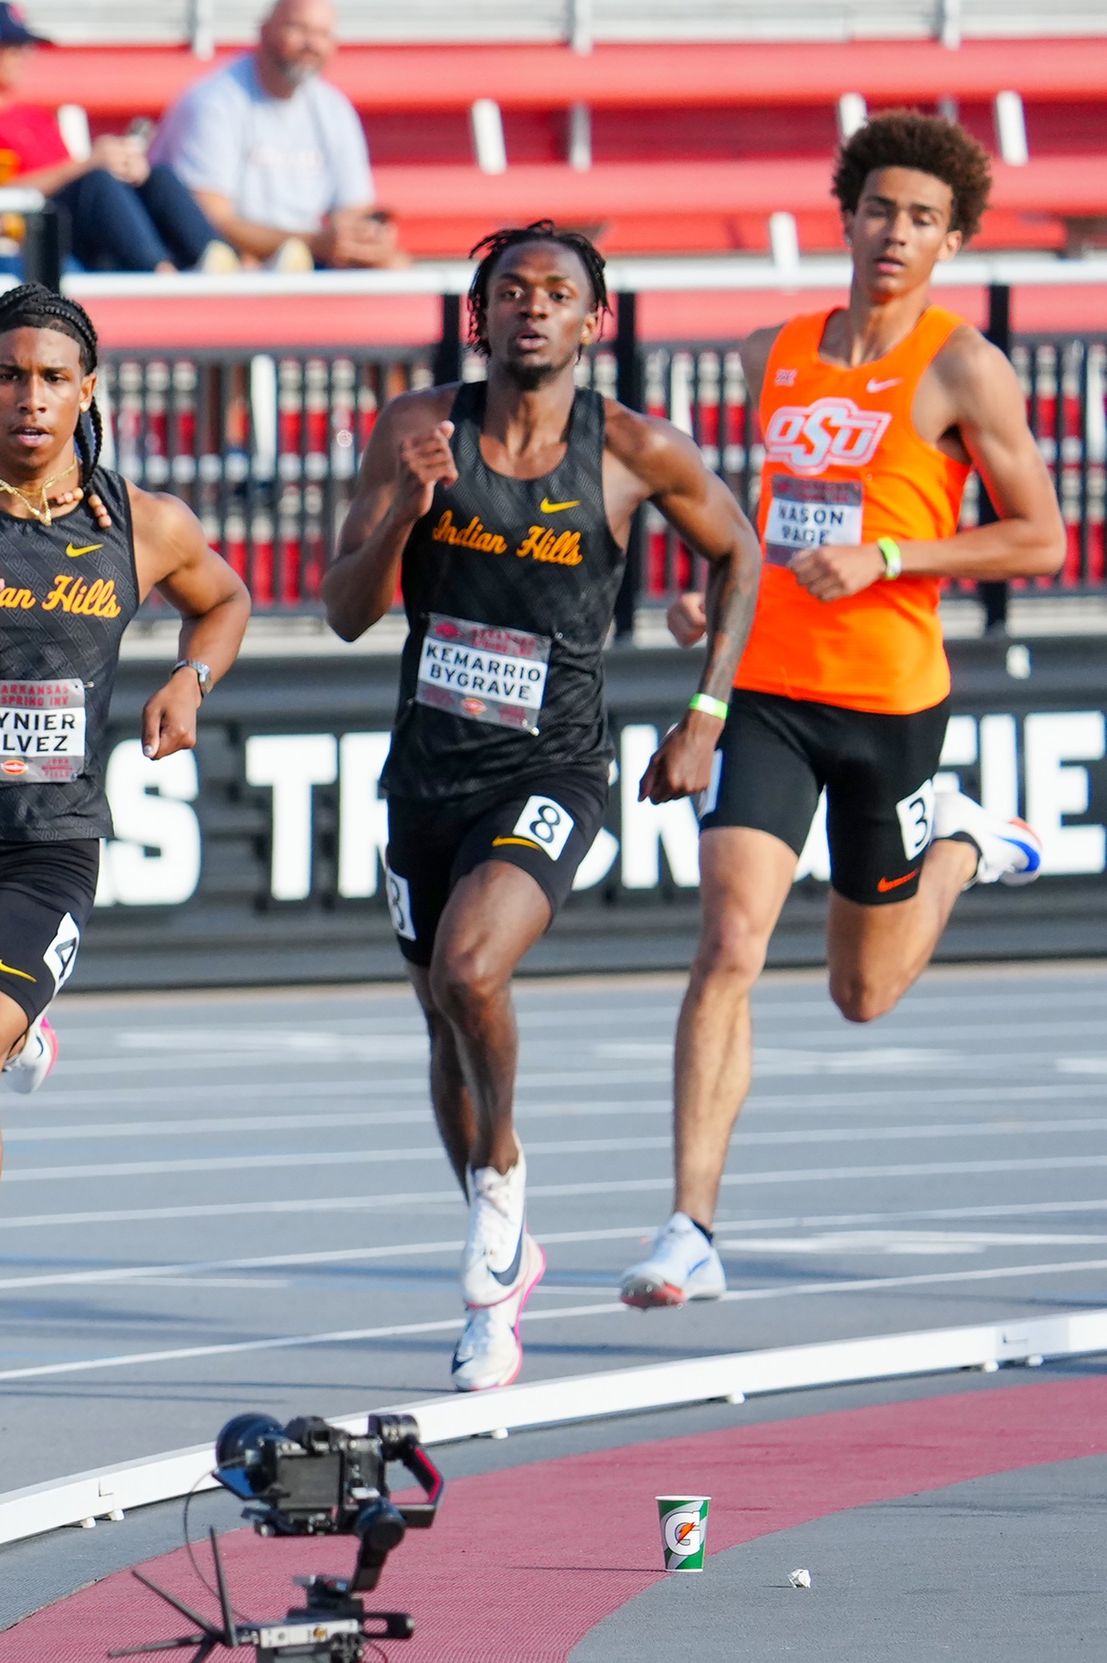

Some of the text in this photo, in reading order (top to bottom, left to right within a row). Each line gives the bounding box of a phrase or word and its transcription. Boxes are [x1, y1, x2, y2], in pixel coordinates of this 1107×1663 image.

[768, 402, 885, 470] OSU
[432, 509, 583, 566] Indian Hills
[42, 575, 121, 619] Hills
[426, 643, 541, 682] KEMARRIO
[430, 663, 531, 700] BYGRAVE
[1, 684, 69, 695] ARKANSAS
[1, 695, 69, 706] SPRING INV
[529, 803, 561, 844] 8
[908, 798, 928, 848] 3
[664, 1511, 701, 1556] G
